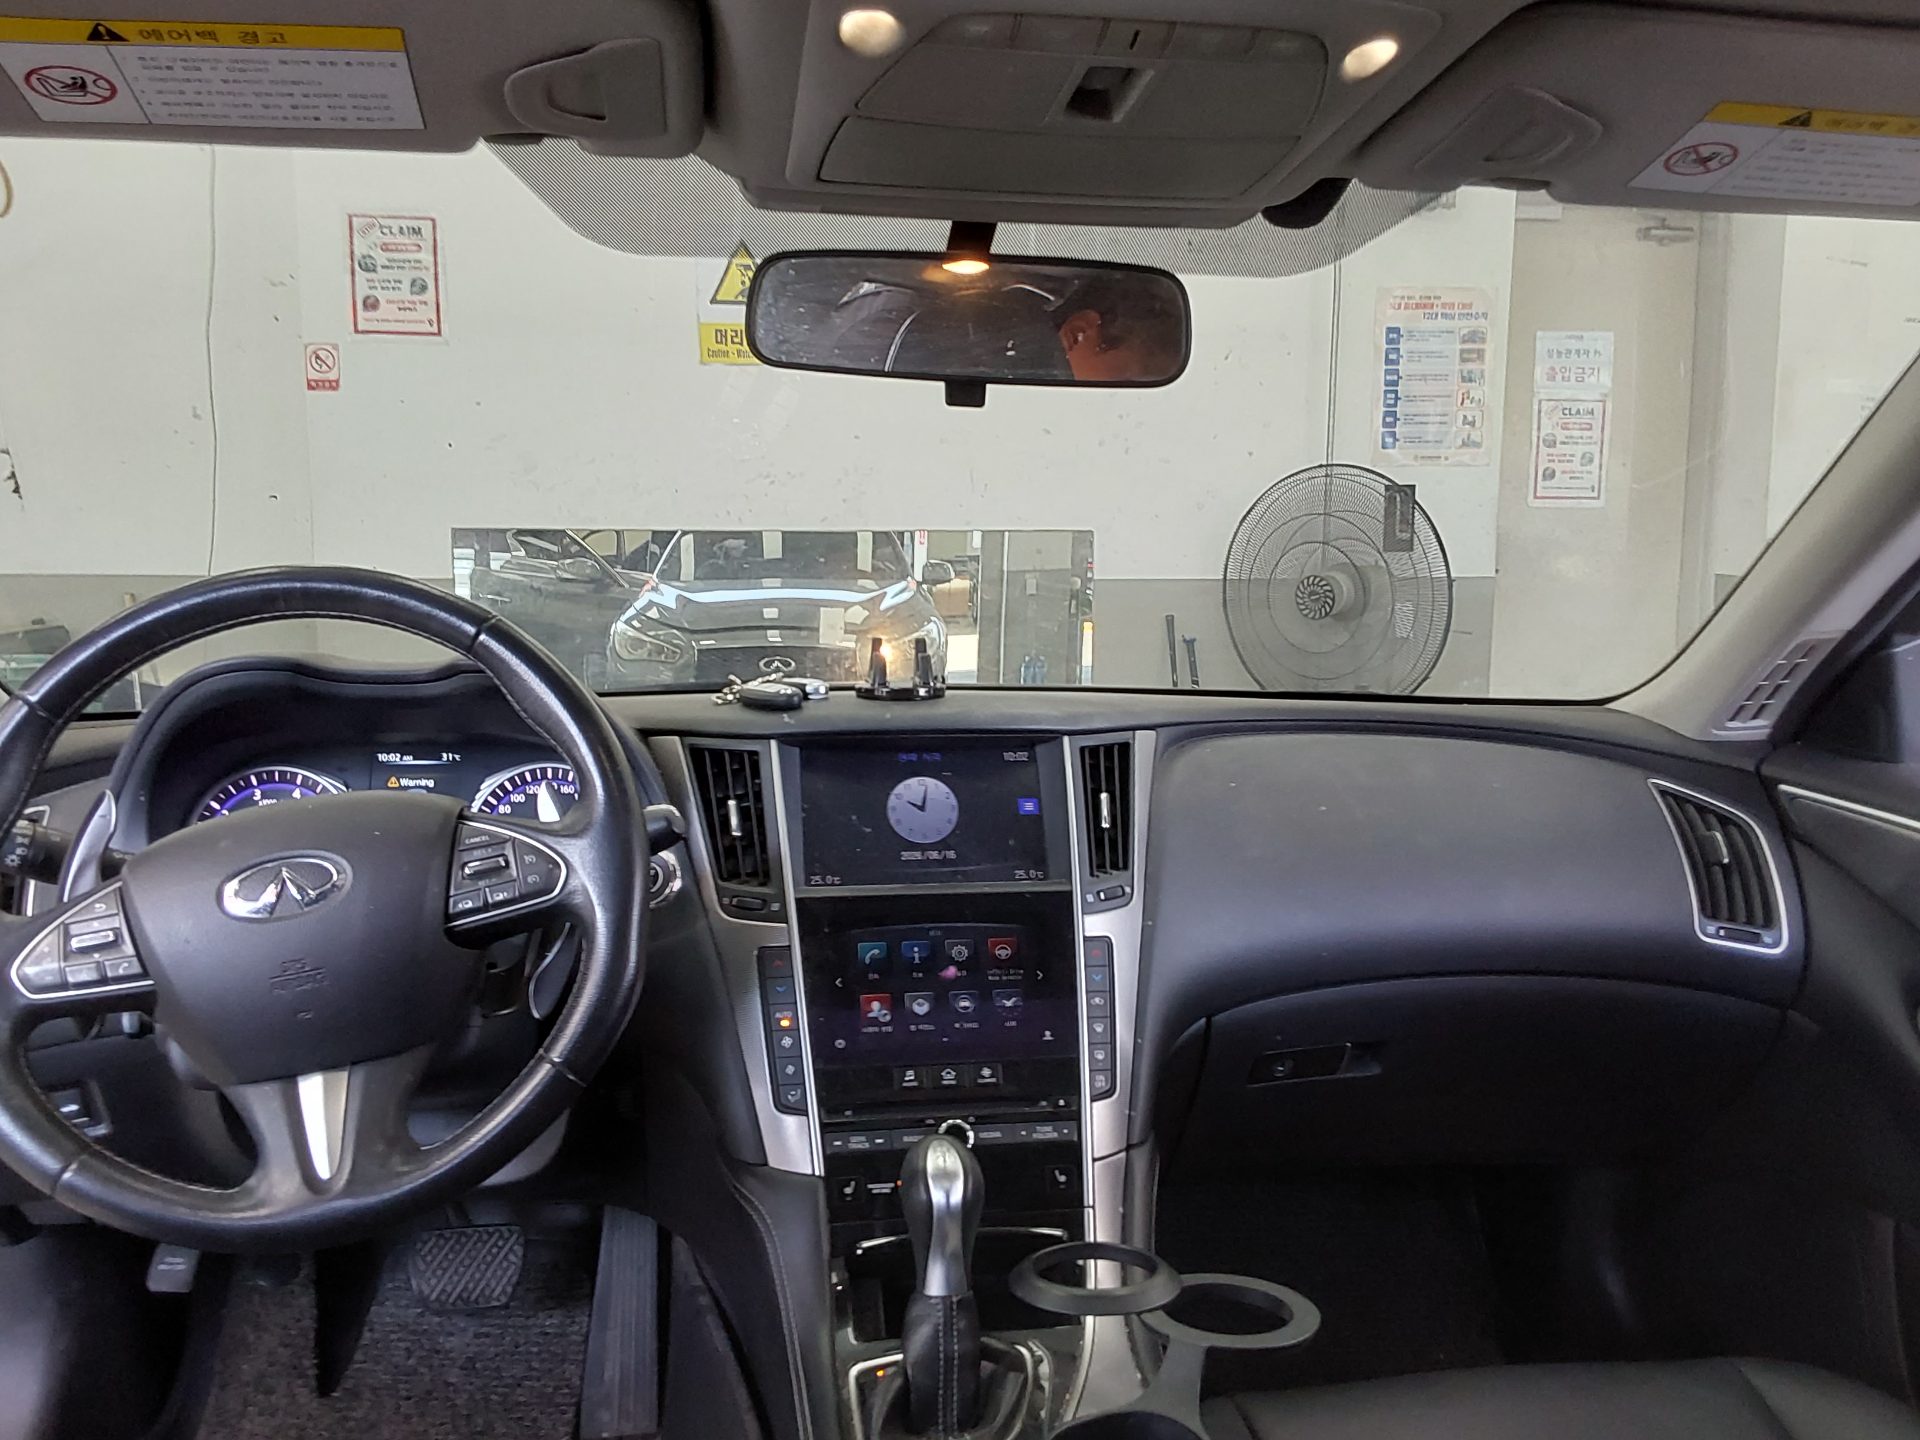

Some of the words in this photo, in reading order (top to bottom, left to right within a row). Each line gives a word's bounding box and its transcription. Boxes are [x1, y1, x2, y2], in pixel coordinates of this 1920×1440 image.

[139, 29, 220, 43] 에어백
[239, 30, 288, 44] 경고
[380, 224, 424, 238] CLAIM
[714, 328, 744, 347] 머리
[707, 347, 730, 359] Caution
[1546, 366, 1600, 383] 출입금지
[1561, 407, 1595, 417] CLAIM
[377, 753, 401, 762] 10:02
[400, 777, 434, 788] Warning
[291, 787, 301, 800] 4
[525, 785, 540, 795] 120
[560, 784, 575, 794] 160
[252, 788, 262, 801] 3
[510, 793, 526, 803] 100
[498, 804, 512, 814] 80
[464, 835, 490, 845] CANCEL
[774, 1011, 793, 1019] AUTO
